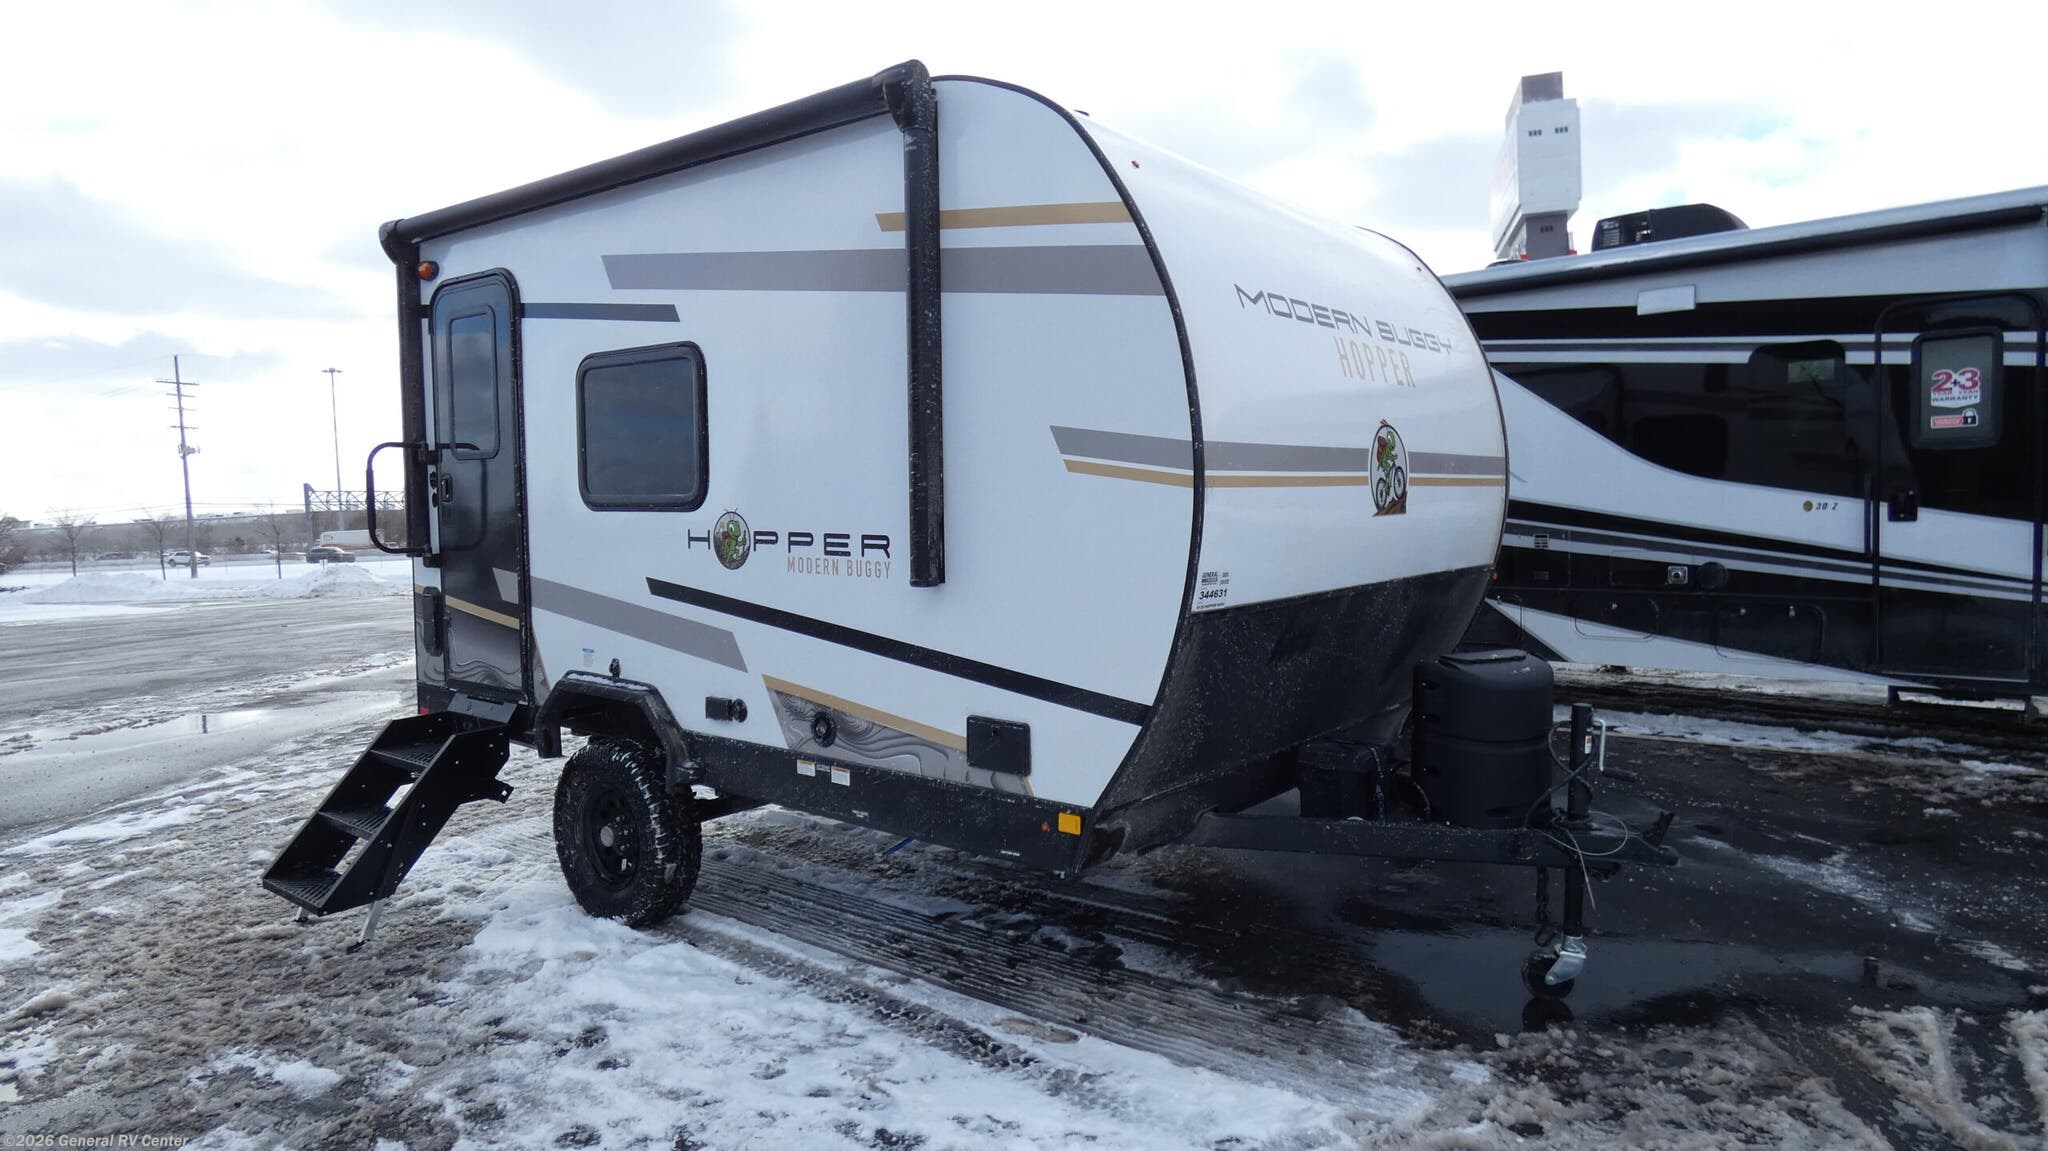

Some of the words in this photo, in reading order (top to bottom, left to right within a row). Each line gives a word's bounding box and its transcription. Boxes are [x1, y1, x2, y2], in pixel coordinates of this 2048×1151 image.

[1234, 283, 1372, 336] MODERN
[1376, 319, 1454, 355] BUGGY
[1334, 336, 1416, 388] HOPPER
[787, 556, 839, 576] MODERN
[846, 559, 892, 579] BUGGY
[1199, 588, 1228, 600] 344631
